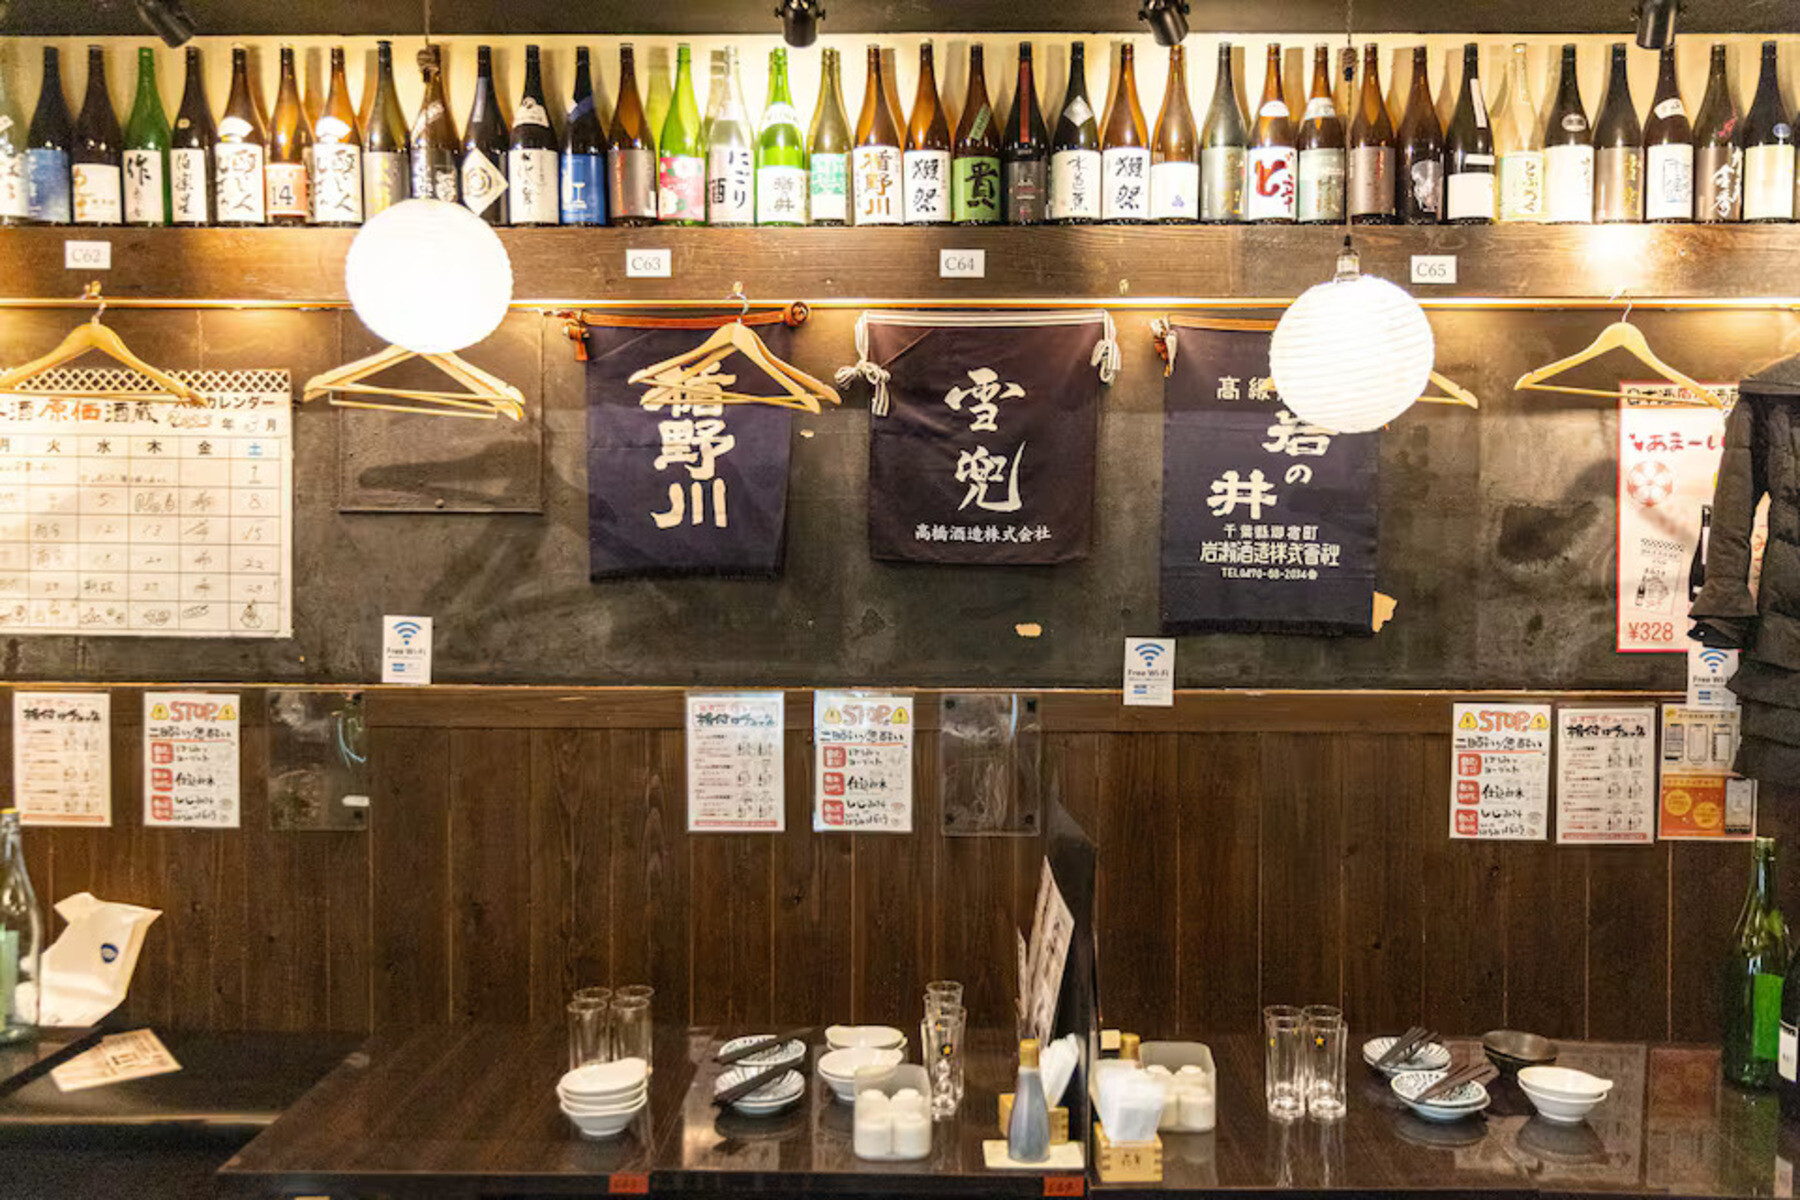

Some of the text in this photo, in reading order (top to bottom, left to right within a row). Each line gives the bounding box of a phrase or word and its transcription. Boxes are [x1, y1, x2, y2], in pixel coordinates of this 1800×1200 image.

[965, 161, 998, 210] 貴
[272, 185, 293, 206] 14
[72, 249, 101, 263] C62
[631, 256, 661, 271] C63
[944, 256, 974, 271] C64
[1416, 263, 1447, 277] C65
[1216, 376, 1284, 401] 高級
[47, 438, 61, 453] 火
[97, 438, 111, 454] 水
[147, 439, 162, 454] 木
[197, 439, 212, 455] 金
[247, 442, 262, 456] 土
[914, 523, 1052, 543] 高橋酒造株式会社
[1628, 622, 1674, 641] ¥328
[1692, 675, 1711, 684] Free
